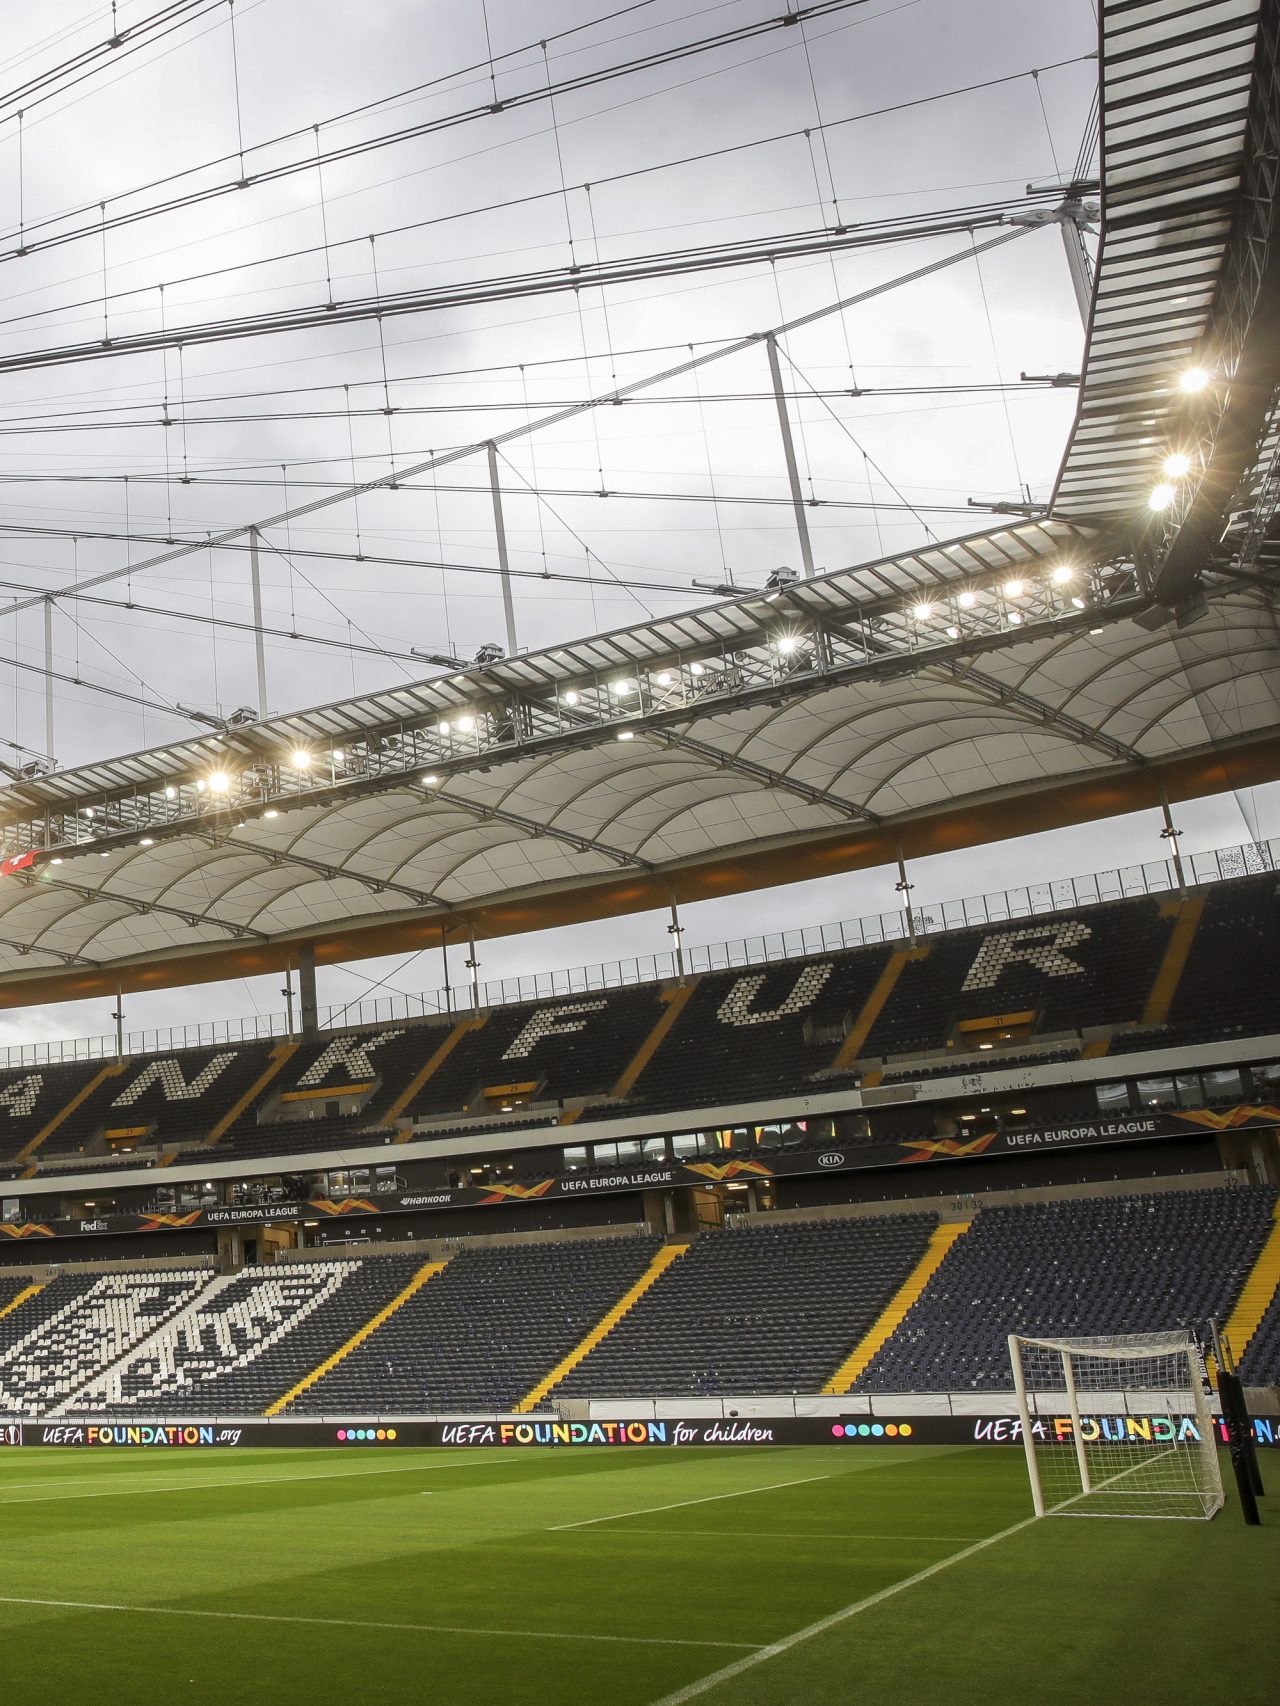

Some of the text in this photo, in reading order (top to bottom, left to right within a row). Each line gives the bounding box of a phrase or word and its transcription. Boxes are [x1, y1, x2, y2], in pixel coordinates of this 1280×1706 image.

[993, 1017, 1004, 1025] 31
[1007, 1134, 1042, 1146] UEFA
[1045, 1127, 1097, 1143] EUROPA
[561, 1181, 587, 1191] UEFA
[589, 1177, 629, 1189] EUROPA
[951, 1200, 983, 1211] 30 32
[208, 1212, 229, 1221] UEFA
[232, 1209, 263, 1219] EUROPA
[80, 1220, 108, 1232] FedEx
[43, 1427, 85, 1442] UEFA
[442, 1422, 774, 1446] UEFA FOUNDATION for children
